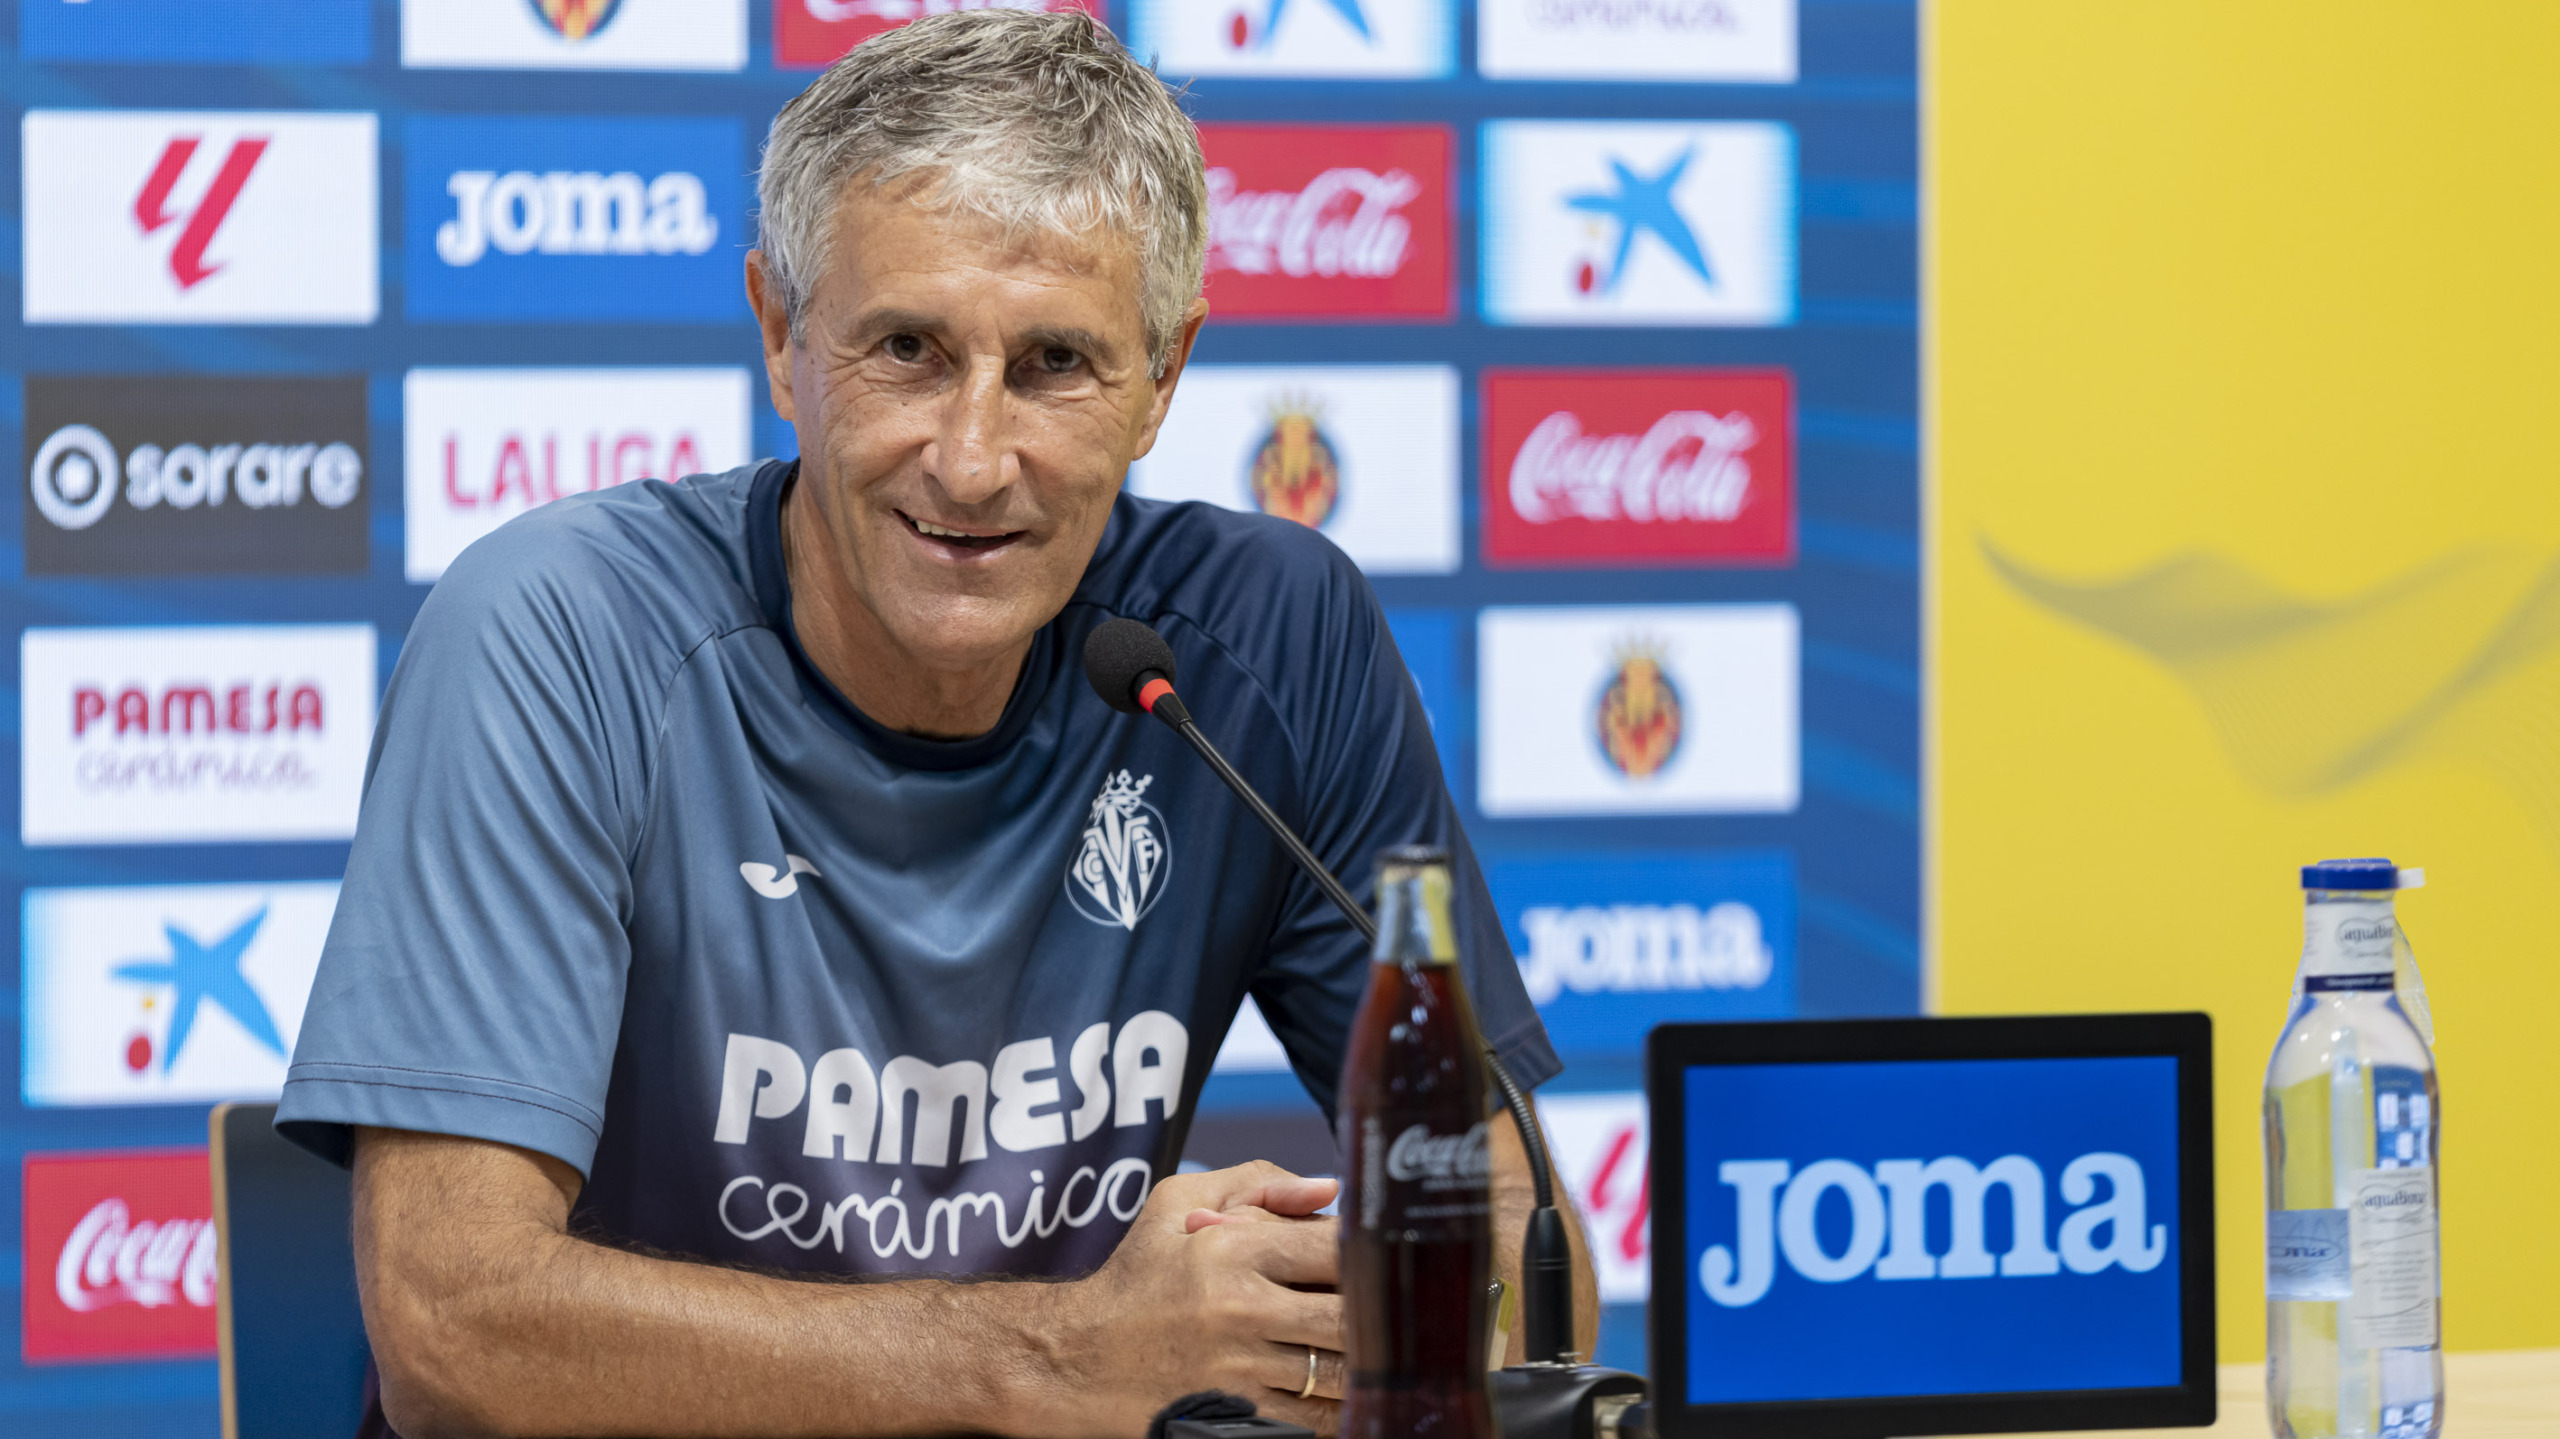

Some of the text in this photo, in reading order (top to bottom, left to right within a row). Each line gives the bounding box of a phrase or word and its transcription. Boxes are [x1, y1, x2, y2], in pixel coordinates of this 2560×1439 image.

[126, 441, 363, 511] sorare
[443, 435, 703, 508] LALIGA
[1508, 409, 1760, 524] Coca-Cola
[74, 682, 323, 738] PAMESA
[713, 1009, 1190, 1167] PAMESA
